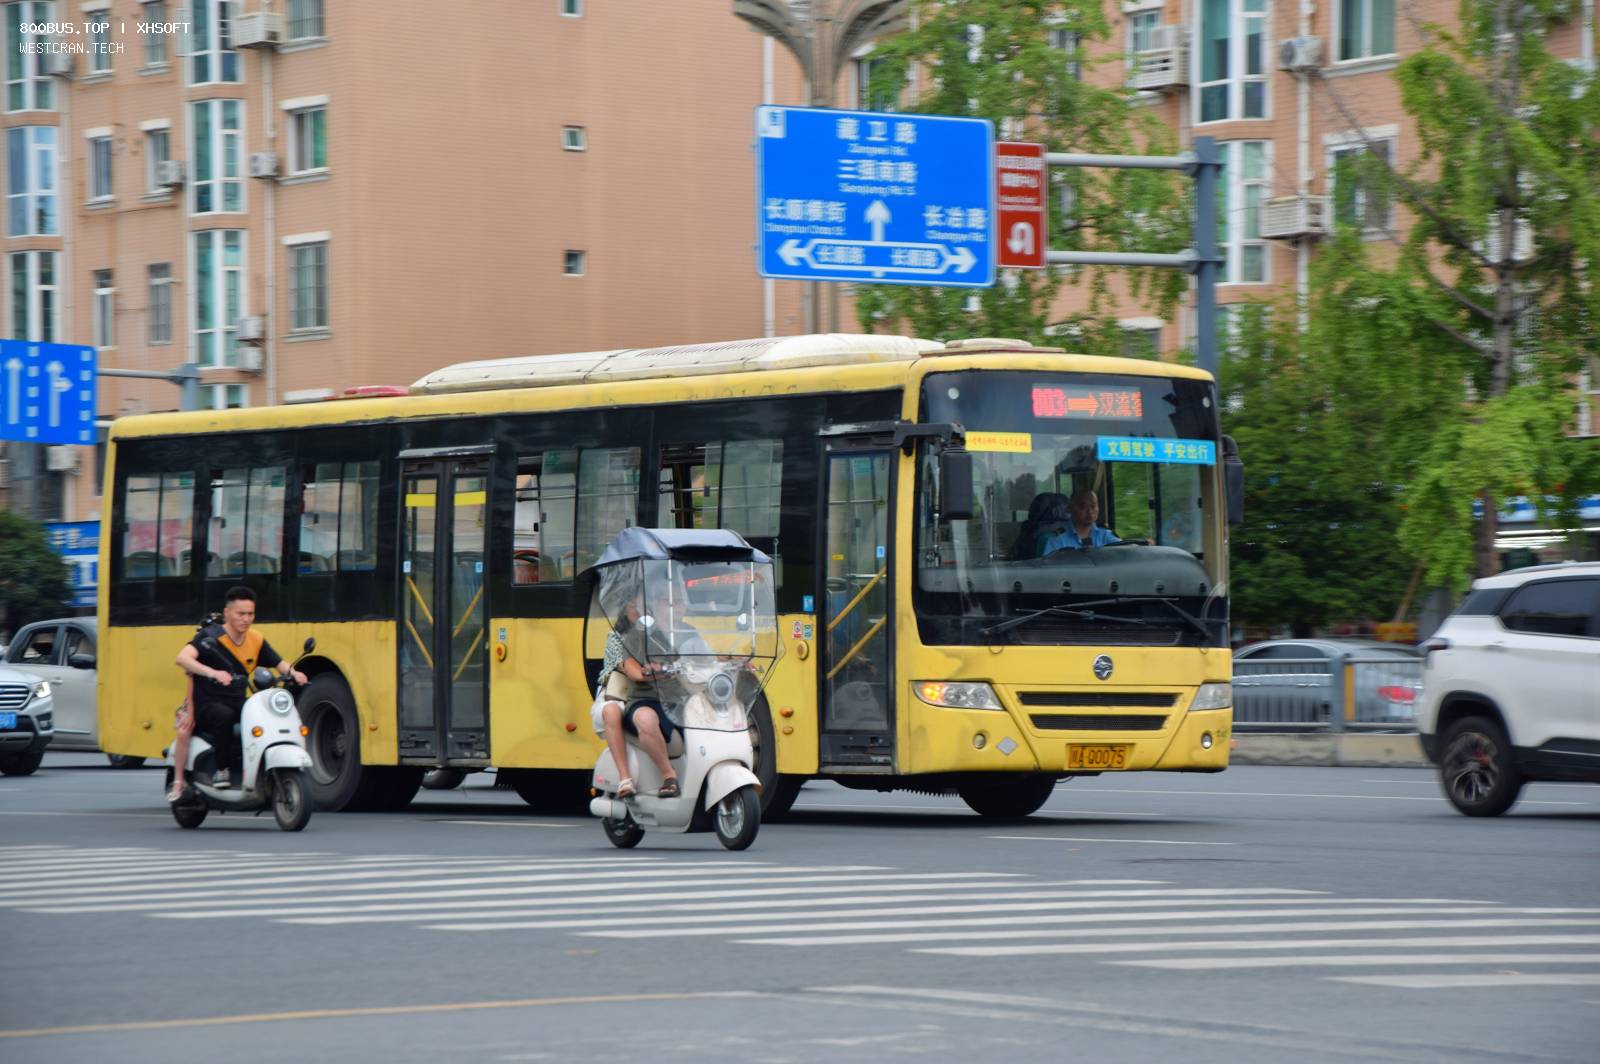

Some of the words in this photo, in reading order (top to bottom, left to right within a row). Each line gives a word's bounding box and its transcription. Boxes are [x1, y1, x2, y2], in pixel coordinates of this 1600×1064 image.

[1107, 441, 1155, 457] 文明驾驶
[1163, 443, 1208, 460] 平安出行
